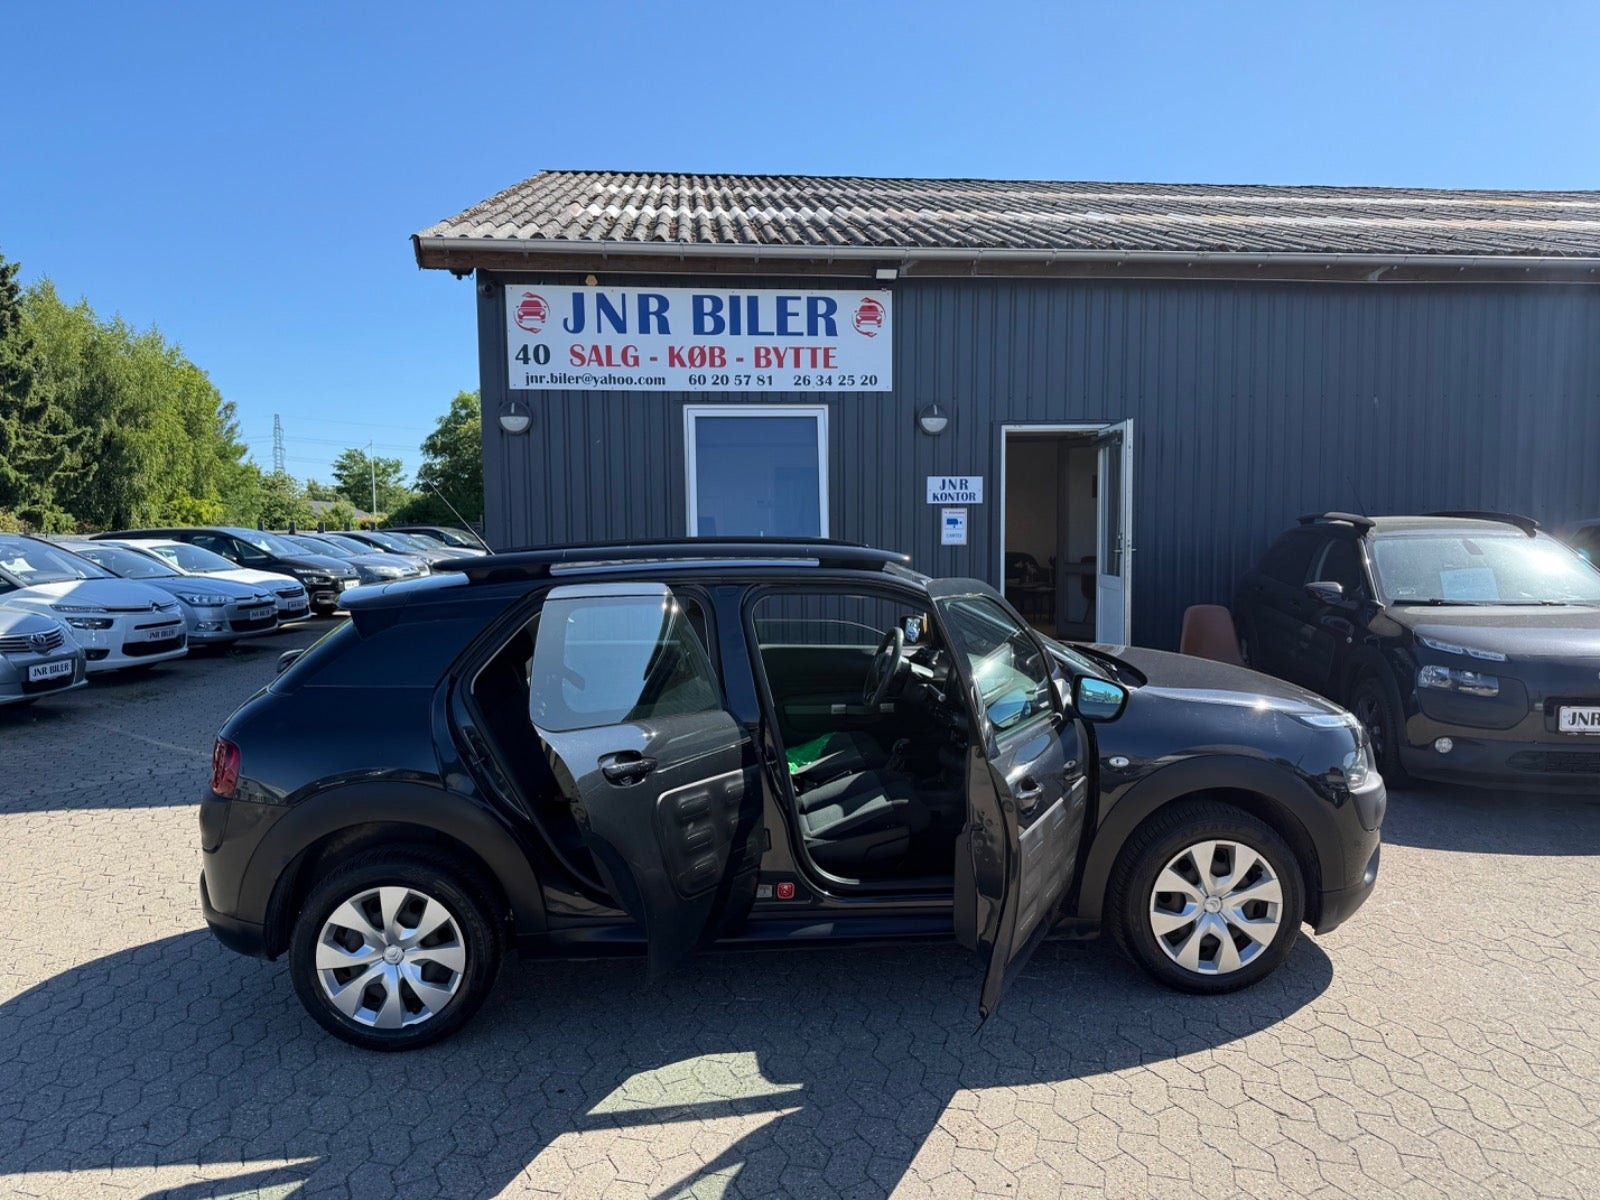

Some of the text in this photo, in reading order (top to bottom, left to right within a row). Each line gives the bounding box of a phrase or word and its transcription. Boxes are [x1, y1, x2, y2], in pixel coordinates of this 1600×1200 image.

[562, 292, 838, 337] JNR BILER
[514, 343, 551, 366] 40
[569, 343, 640, 368] SALG
[668, 345, 727, 370] KØB
[754, 346, 839, 370] BYTTE
[525, 371, 667, 388] jnr.biler@yahoo.com
[688, 374, 773, 387] 60 20 57 81
[793, 375, 878, 387] 26 34 25 20
[940, 478, 969, 491] JNR
[932, 491, 977, 503] KONTOR
[33, 662, 70, 678] JNR BILER
[1567, 711, 1600, 727] JNR
